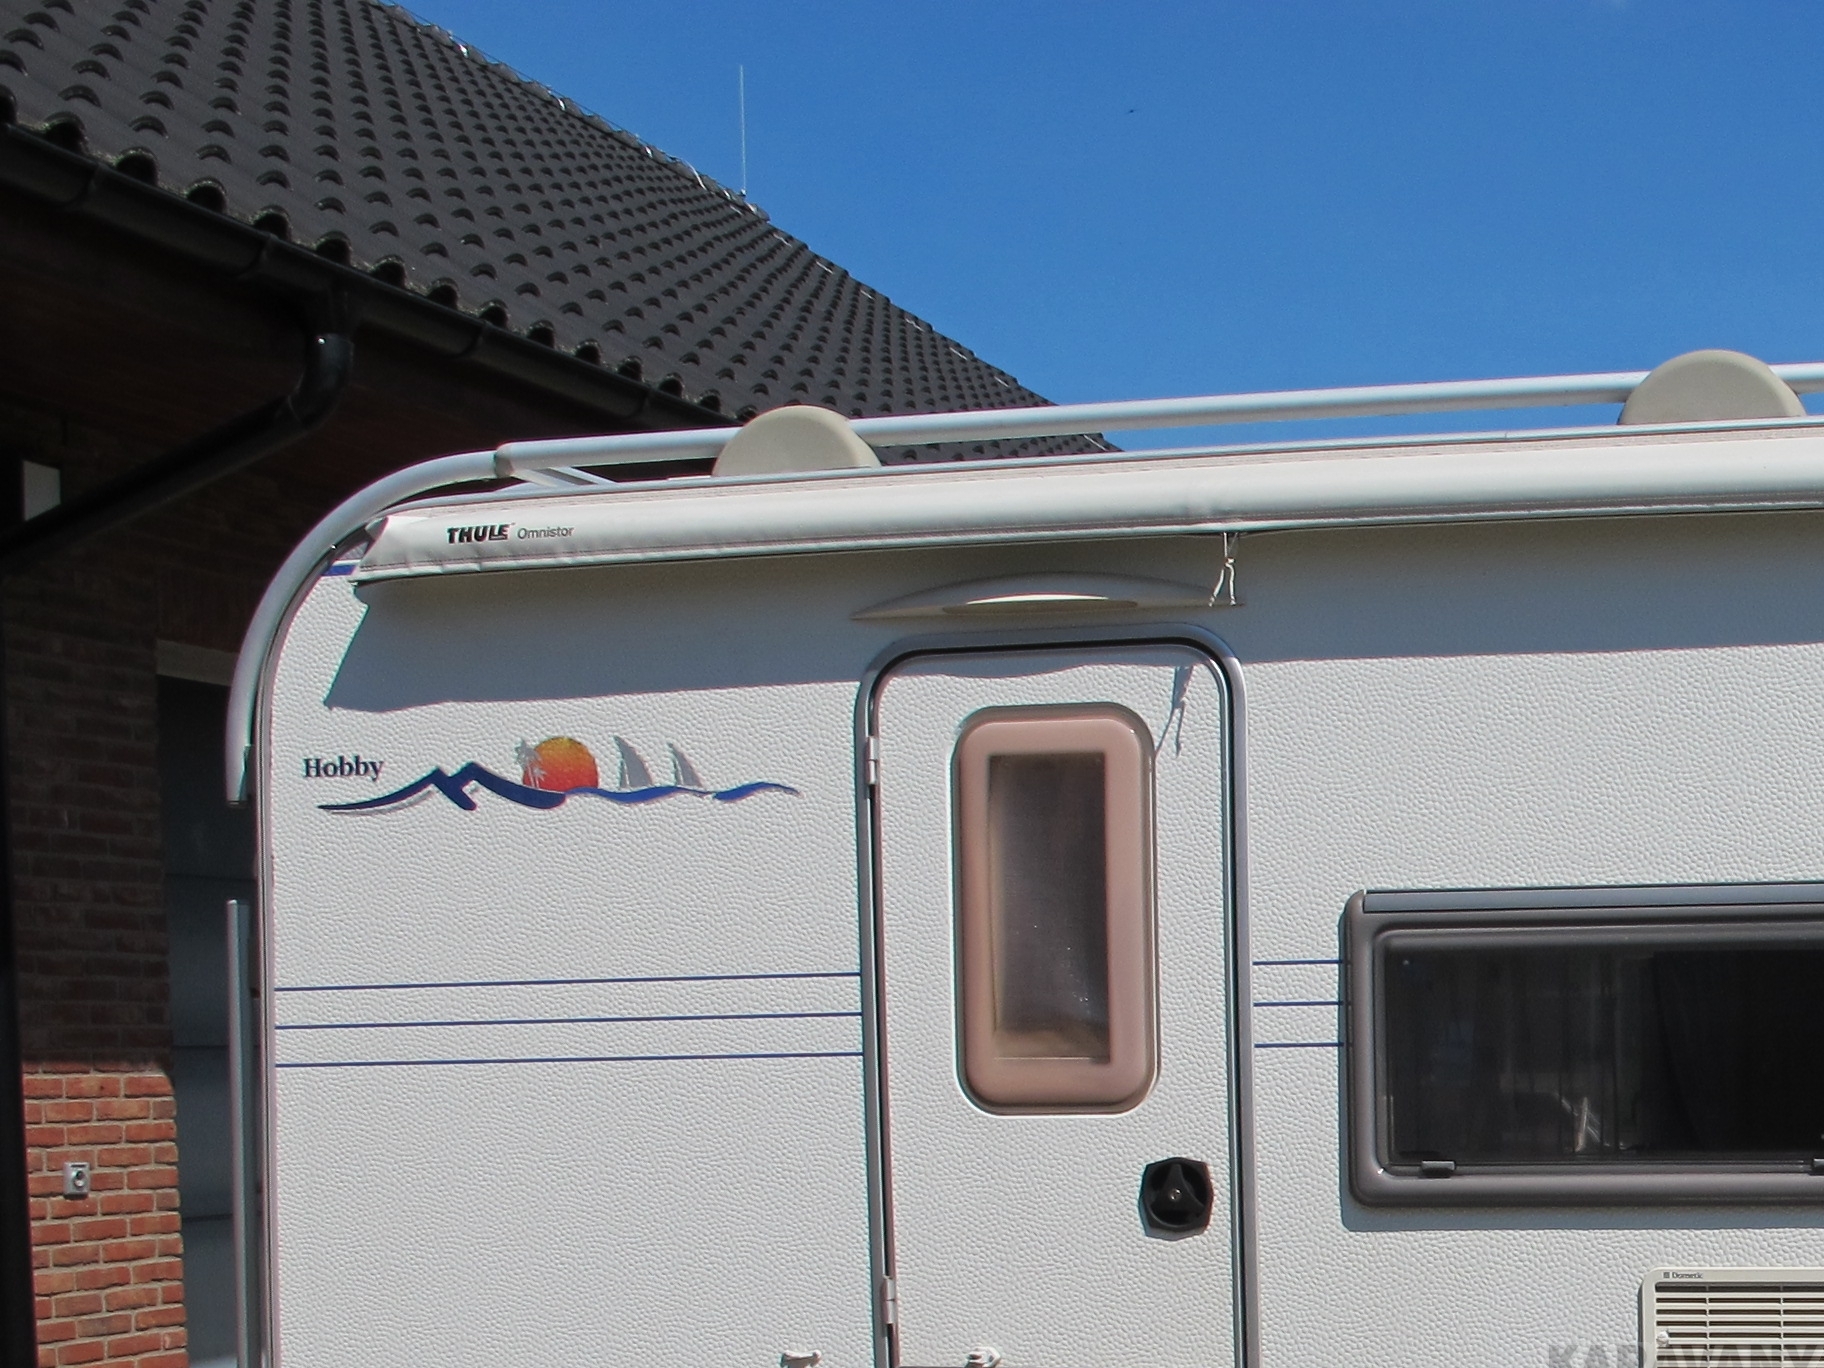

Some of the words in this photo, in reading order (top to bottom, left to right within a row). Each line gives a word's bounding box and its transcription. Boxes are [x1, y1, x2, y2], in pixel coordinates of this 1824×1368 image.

[447, 524, 510, 544] THULE
[517, 527, 575, 540] Omnistor
[303, 755, 384, 782] Hobby
